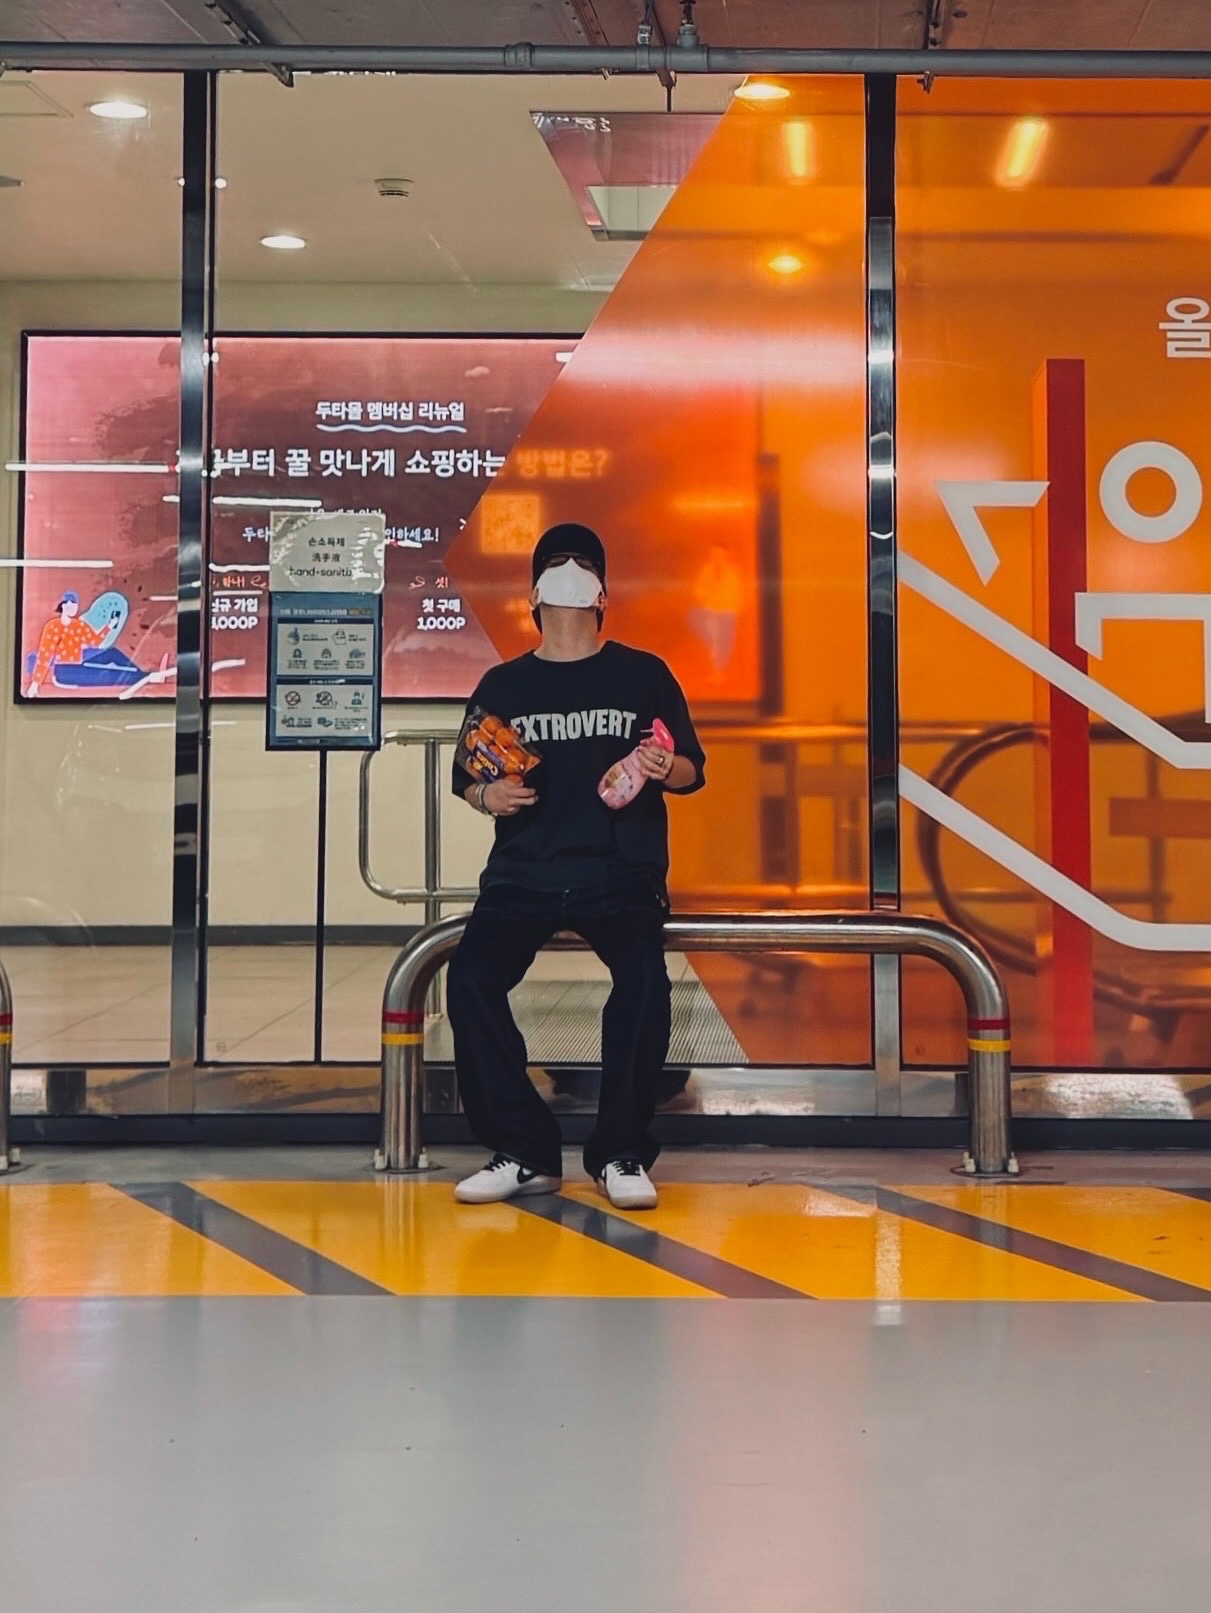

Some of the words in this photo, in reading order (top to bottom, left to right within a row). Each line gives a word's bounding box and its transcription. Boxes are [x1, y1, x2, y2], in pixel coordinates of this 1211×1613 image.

[315, 401, 363, 421] 두타몰
[366, 401, 413, 421] 멤버십
[418, 401, 465, 421] 리뉴얼
[203, 448, 275, 477] 부터
[285, 448, 311, 477] 꿀
[320, 448, 395, 477] 맛나게
[404, 448, 505, 478] 쇼핑하는
[234, 598, 258, 612] 가입
[437, 598, 461, 612] 구매
[417, 616, 466, 630] 1,000P
[510, 709, 637, 743] EXTROVERT
